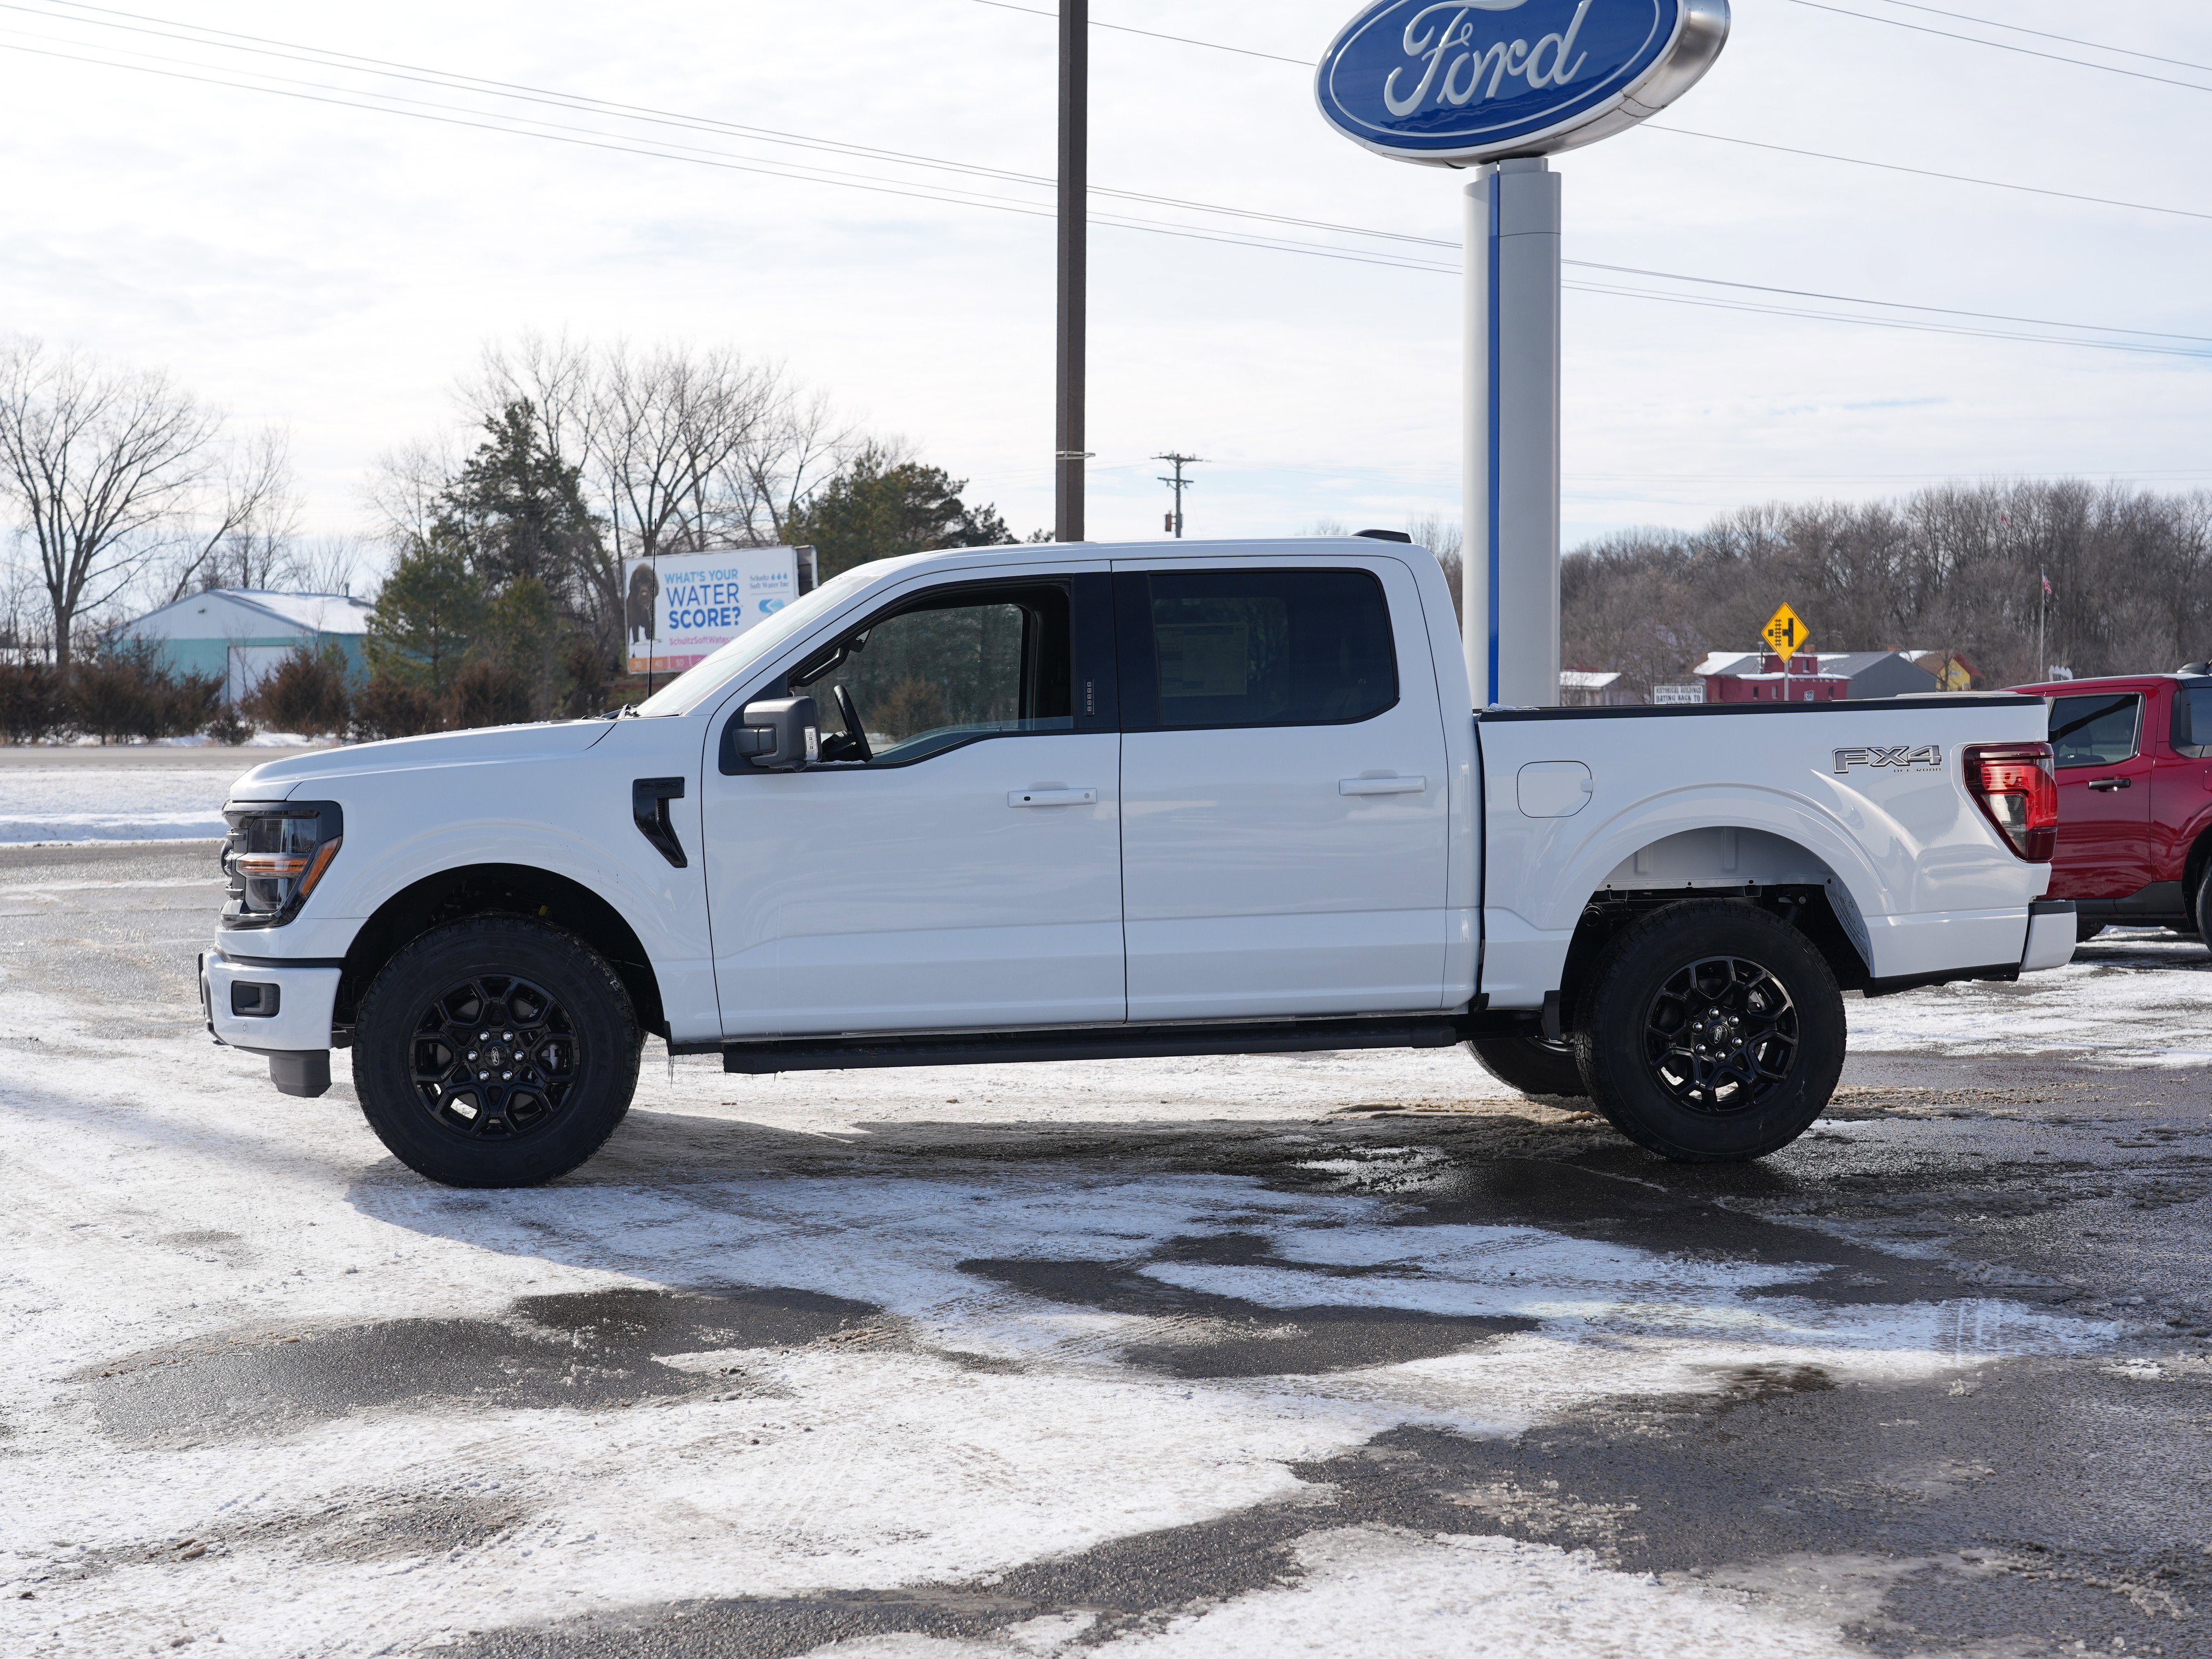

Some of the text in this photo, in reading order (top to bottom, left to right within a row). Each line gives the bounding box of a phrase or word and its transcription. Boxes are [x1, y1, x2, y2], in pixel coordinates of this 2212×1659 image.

[1384, 0, 1591, 116] Ford
[665, 569, 738, 584] WHAT'S YOUR
[666, 583, 739, 608] WATER
[669, 606, 741, 629] SCORE?
[1694, 694, 1700, 702] TO
[1832, 745, 1941, 774] FX4
